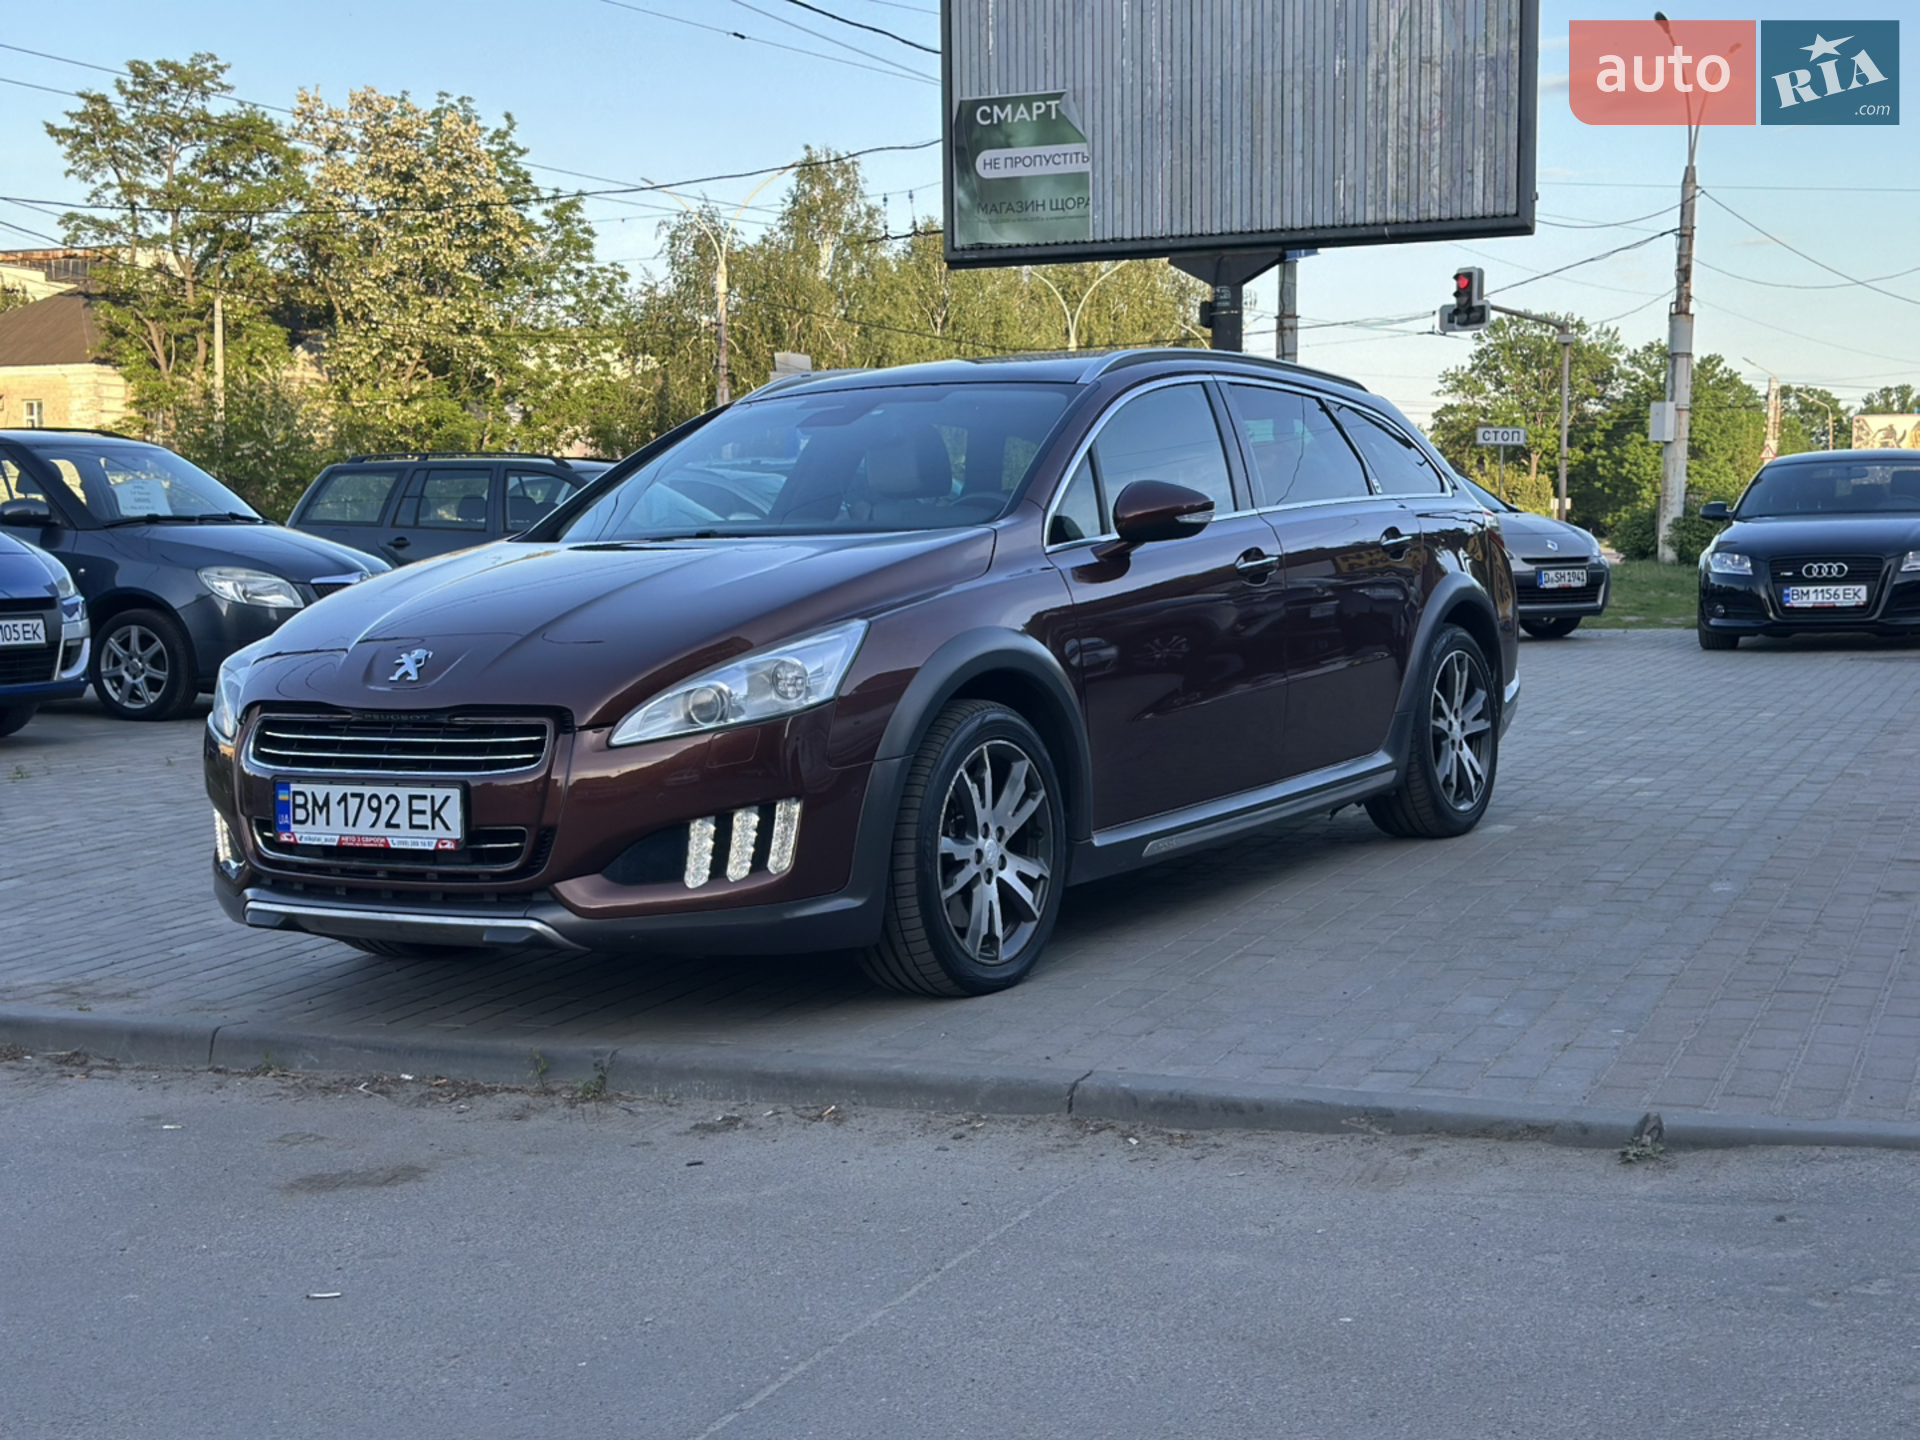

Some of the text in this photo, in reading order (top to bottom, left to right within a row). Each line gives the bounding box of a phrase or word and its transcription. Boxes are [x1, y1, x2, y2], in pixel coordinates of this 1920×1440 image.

[976, 100, 1060, 125] СМАРТ
[983, 151, 1090, 171] НЕ ПРОПУСТІТЬ
[976, 200, 1046, 215] МАГАЗИН
[1482, 430, 1520, 442] СТОП
